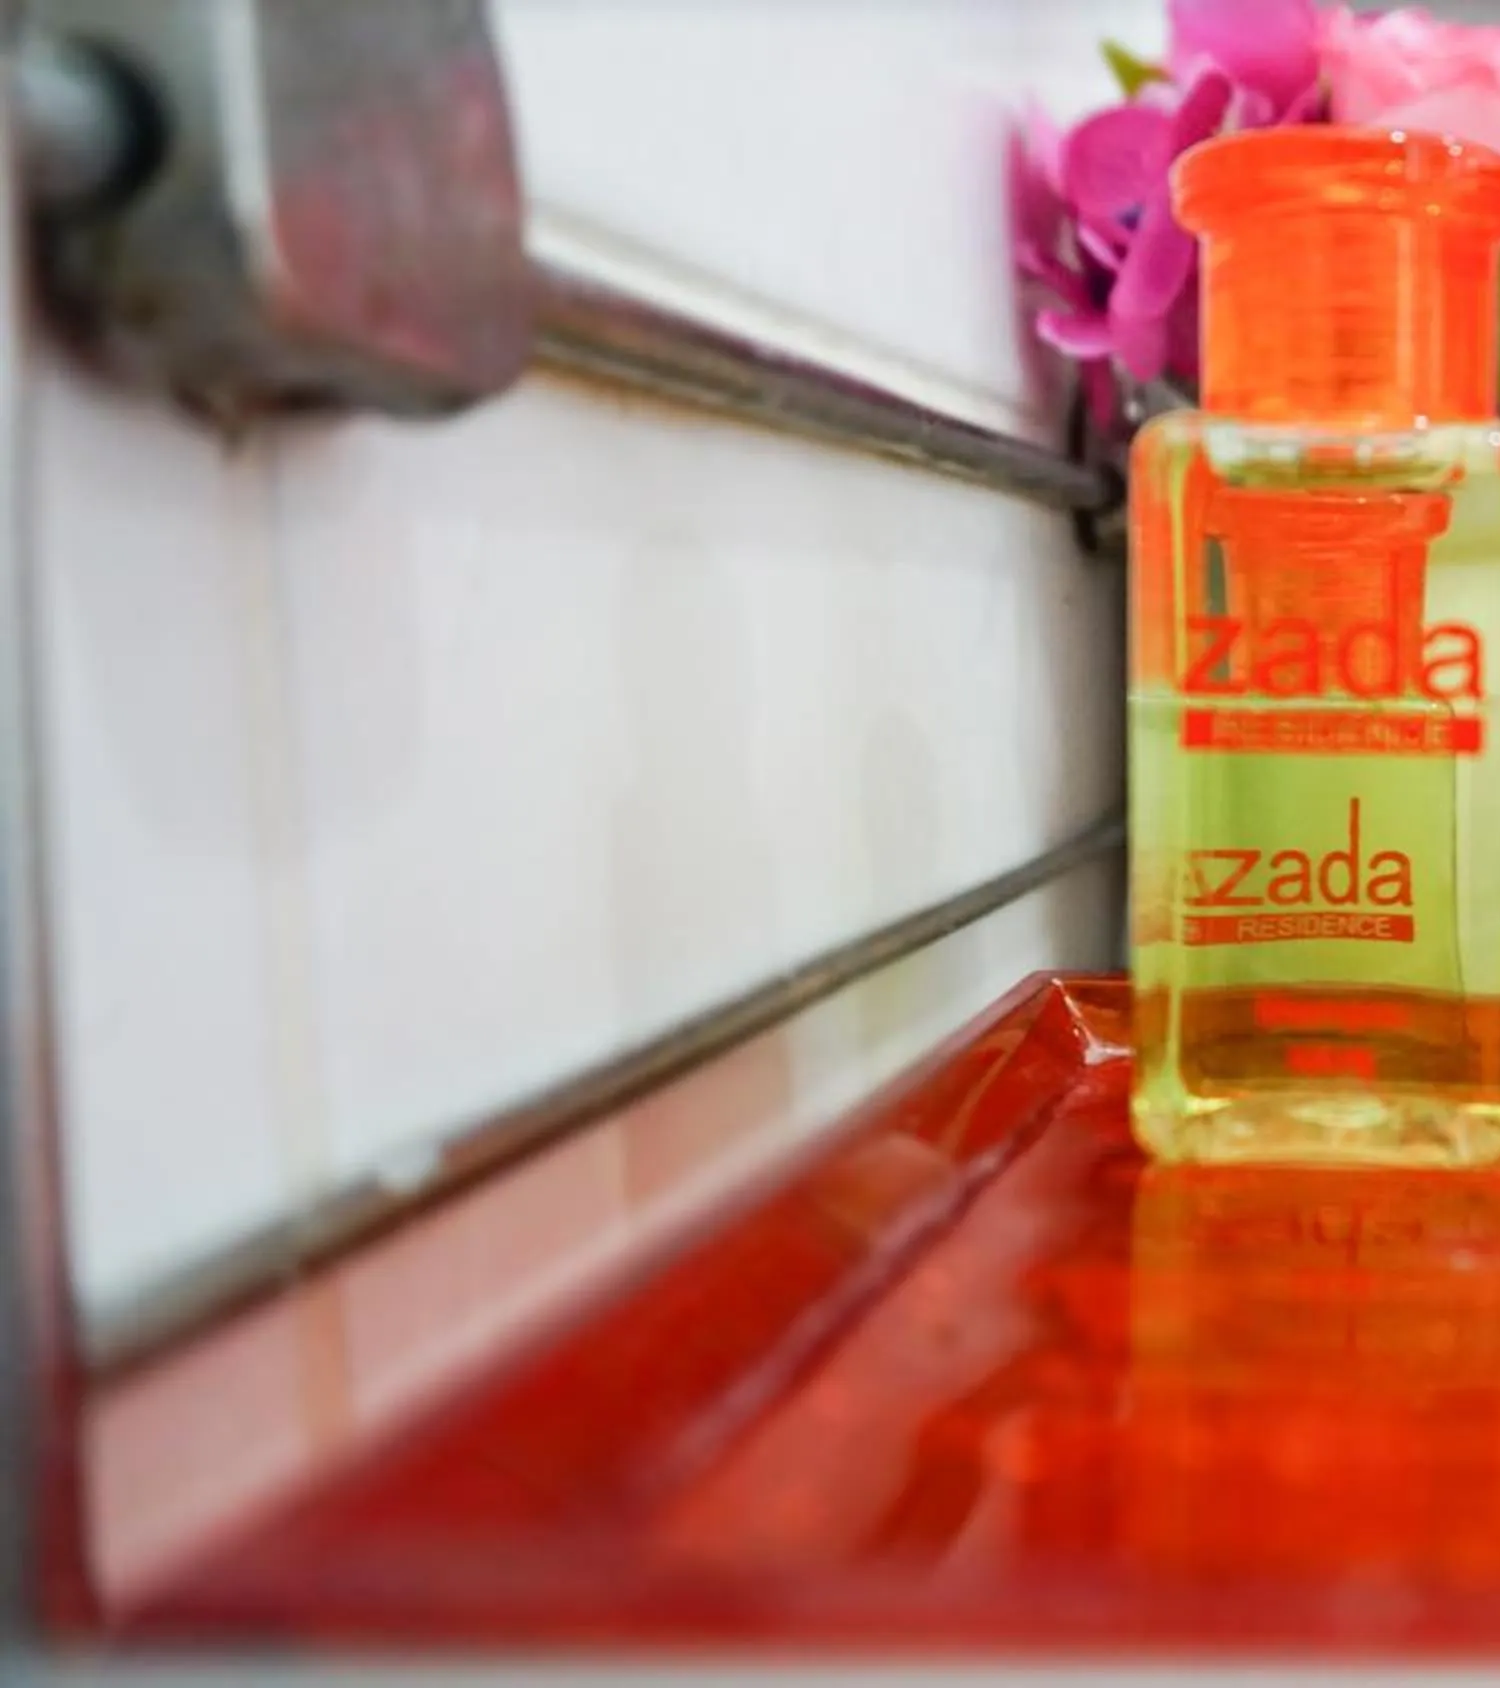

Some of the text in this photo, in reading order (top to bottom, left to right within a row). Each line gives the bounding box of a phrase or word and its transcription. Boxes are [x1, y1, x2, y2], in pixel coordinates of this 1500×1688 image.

[1181, 548, 1484, 700] zada
[1205, 796, 1414, 907] zada
[1237, 914, 1394, 942] RESIDENCE
